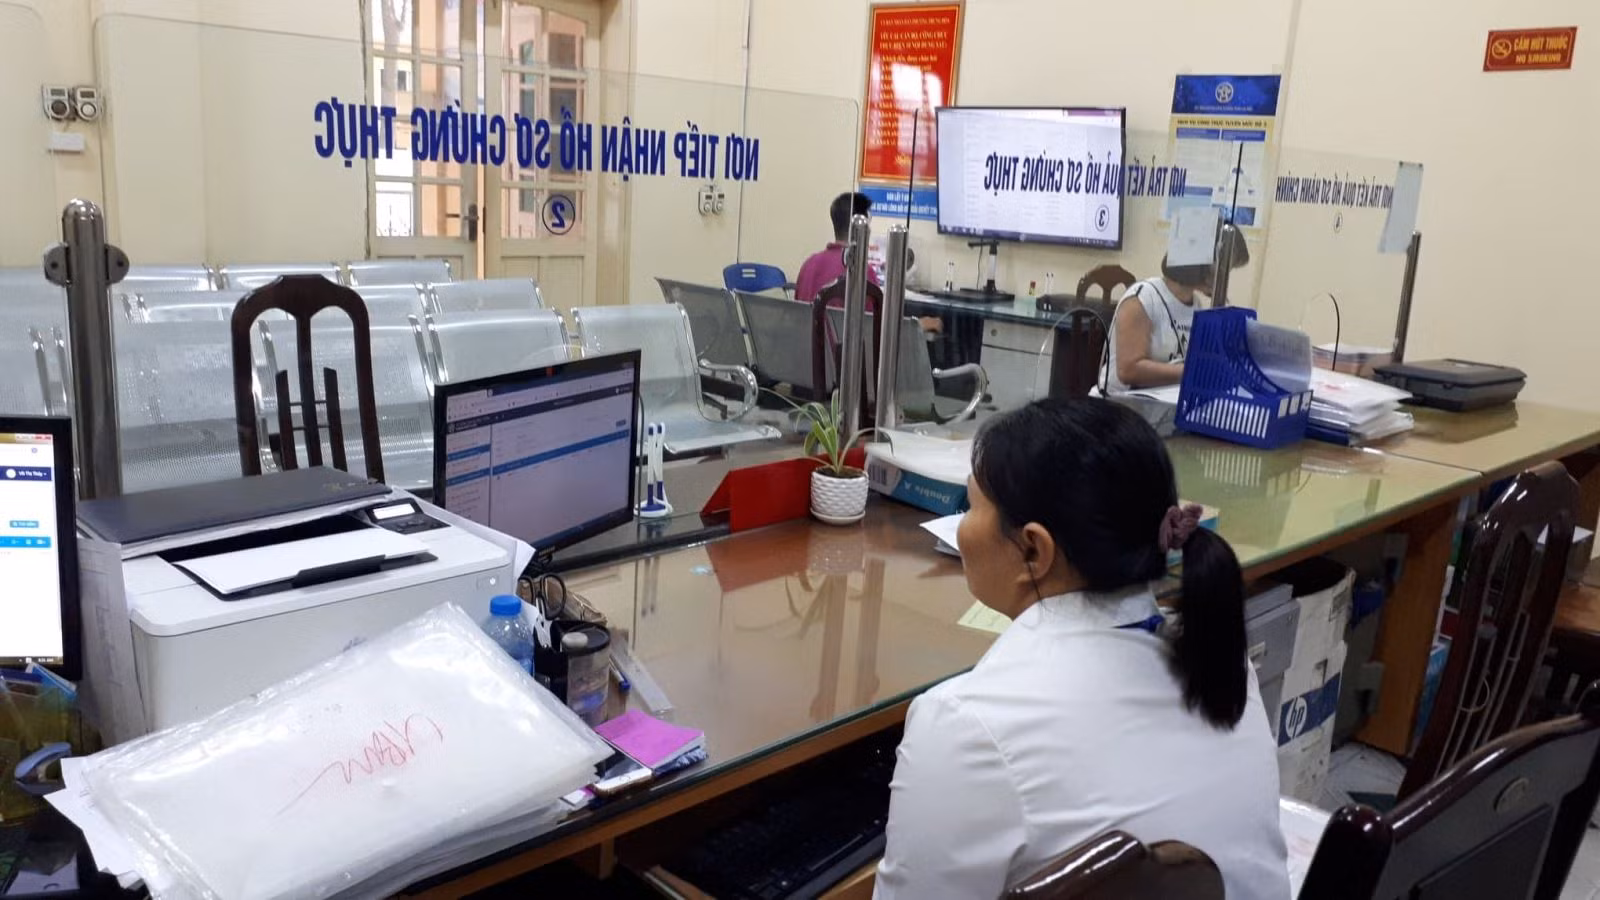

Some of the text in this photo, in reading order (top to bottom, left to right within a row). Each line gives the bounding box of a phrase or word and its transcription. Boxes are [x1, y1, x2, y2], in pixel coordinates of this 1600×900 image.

[904, 480, 951, 504] Double A
[1288, 697, 1305, 739] hp
